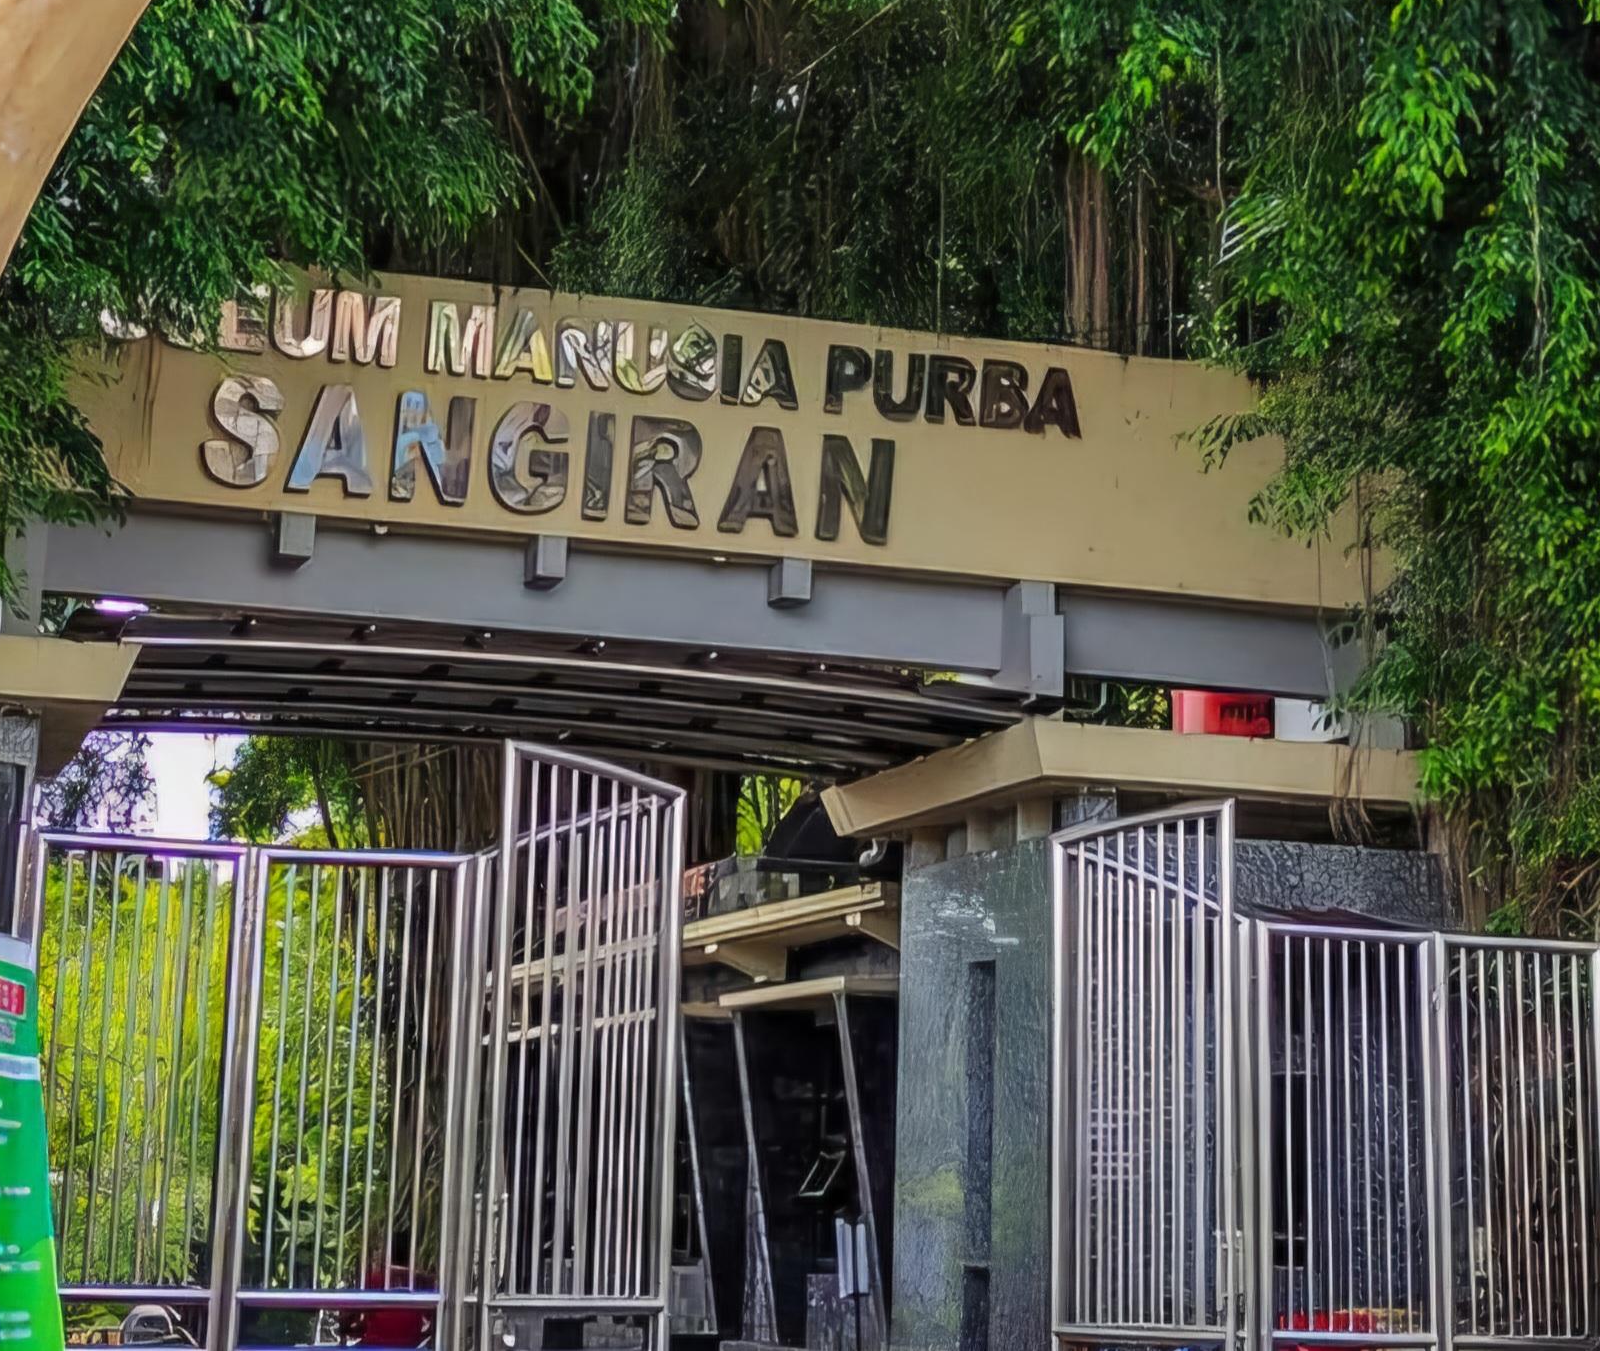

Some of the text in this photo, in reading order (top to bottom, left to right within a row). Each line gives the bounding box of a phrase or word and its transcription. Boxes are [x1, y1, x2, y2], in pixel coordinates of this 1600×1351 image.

[427, 299, 799, 411] MANUSIA
[823, 343, 1083, 441] PURBA
[199, 371, 896, 546] SANGIRAN
